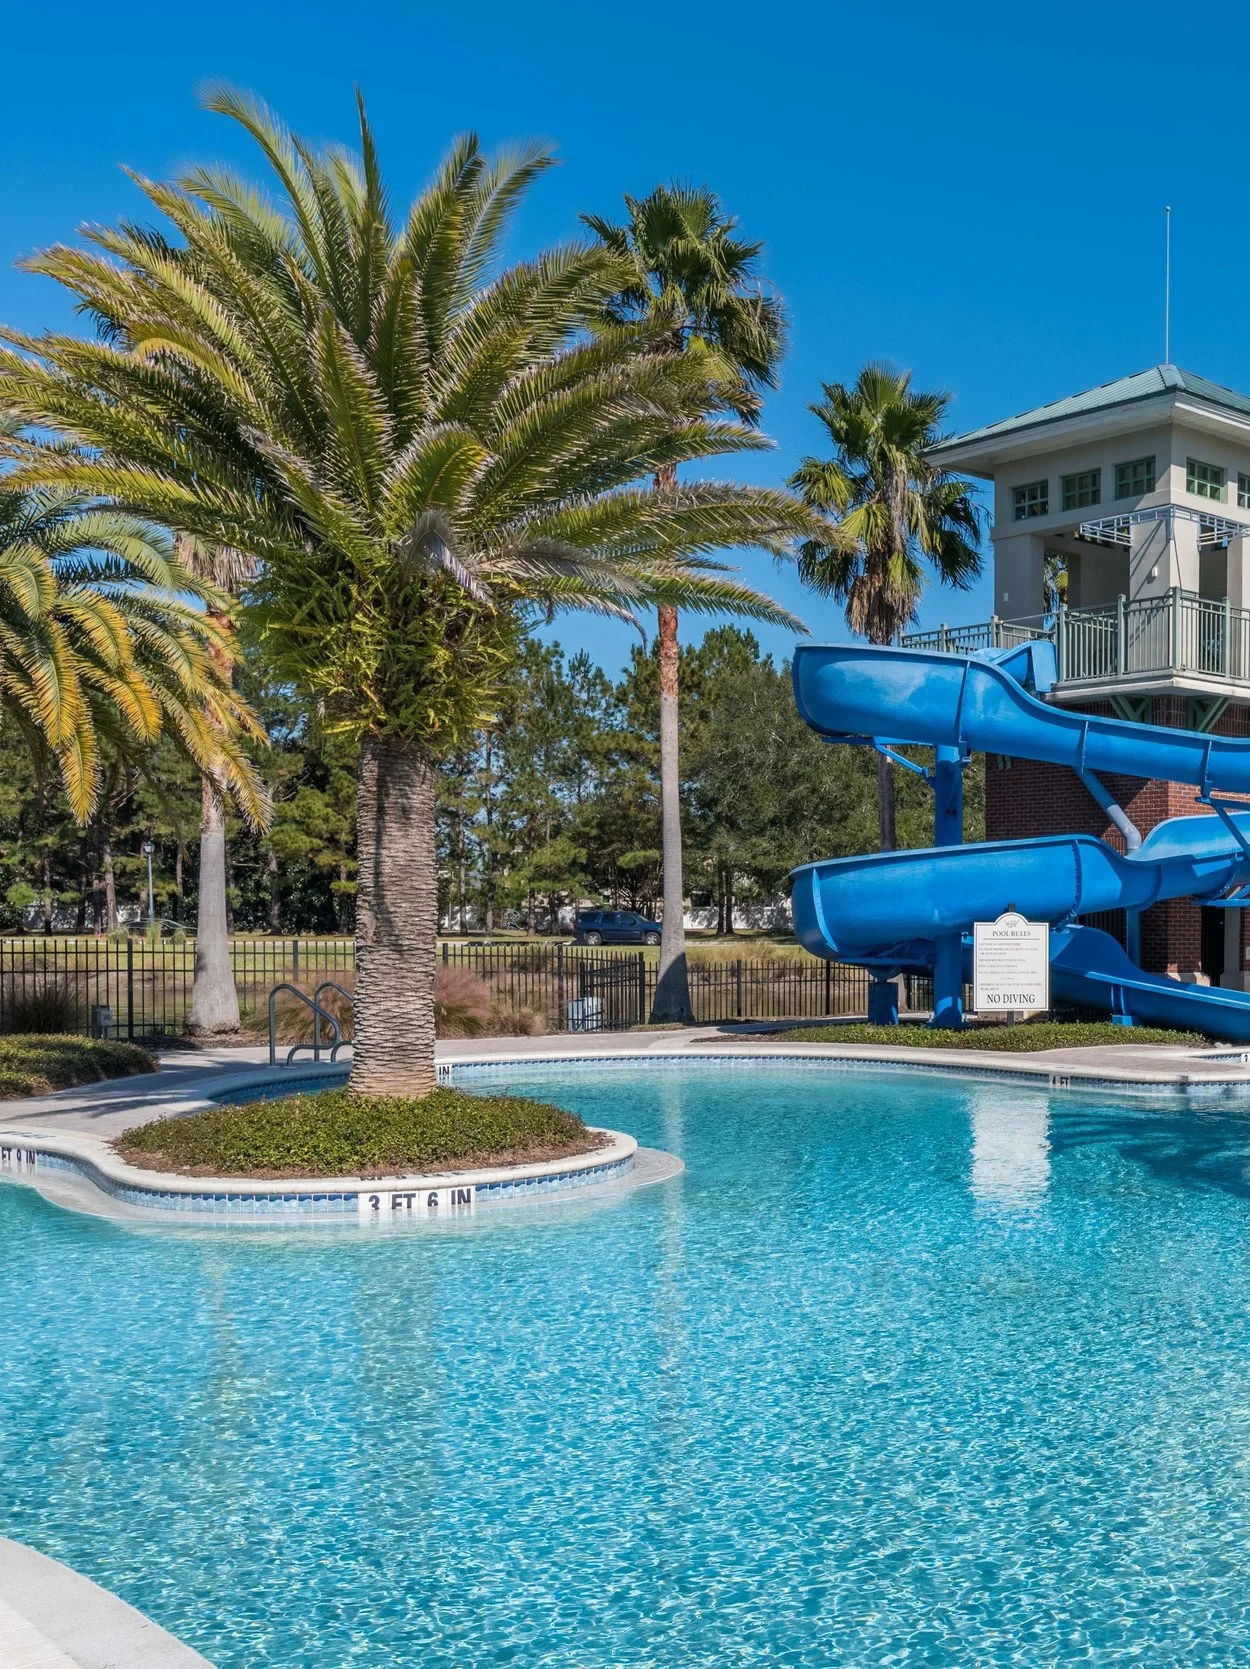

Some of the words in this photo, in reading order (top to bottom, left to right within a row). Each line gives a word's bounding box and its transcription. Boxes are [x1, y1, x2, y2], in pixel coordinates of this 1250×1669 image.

[986, 993, 1001, 1004] NO
[1002, 993, 1036, 1004] DIVING
[439, 1065, 450, 1075] IN
[1060, 1076, 1069, 1086] FT
[1, 1147, 12, 1160] FT
[25, 1149, 36, 1165] IN
[368, 1195, 380, 1210] 3
[391, 1193, 416, 1209] FT
[427, 1191, 439, 1207] 6
[450, 1188, 472, 1205] IN
